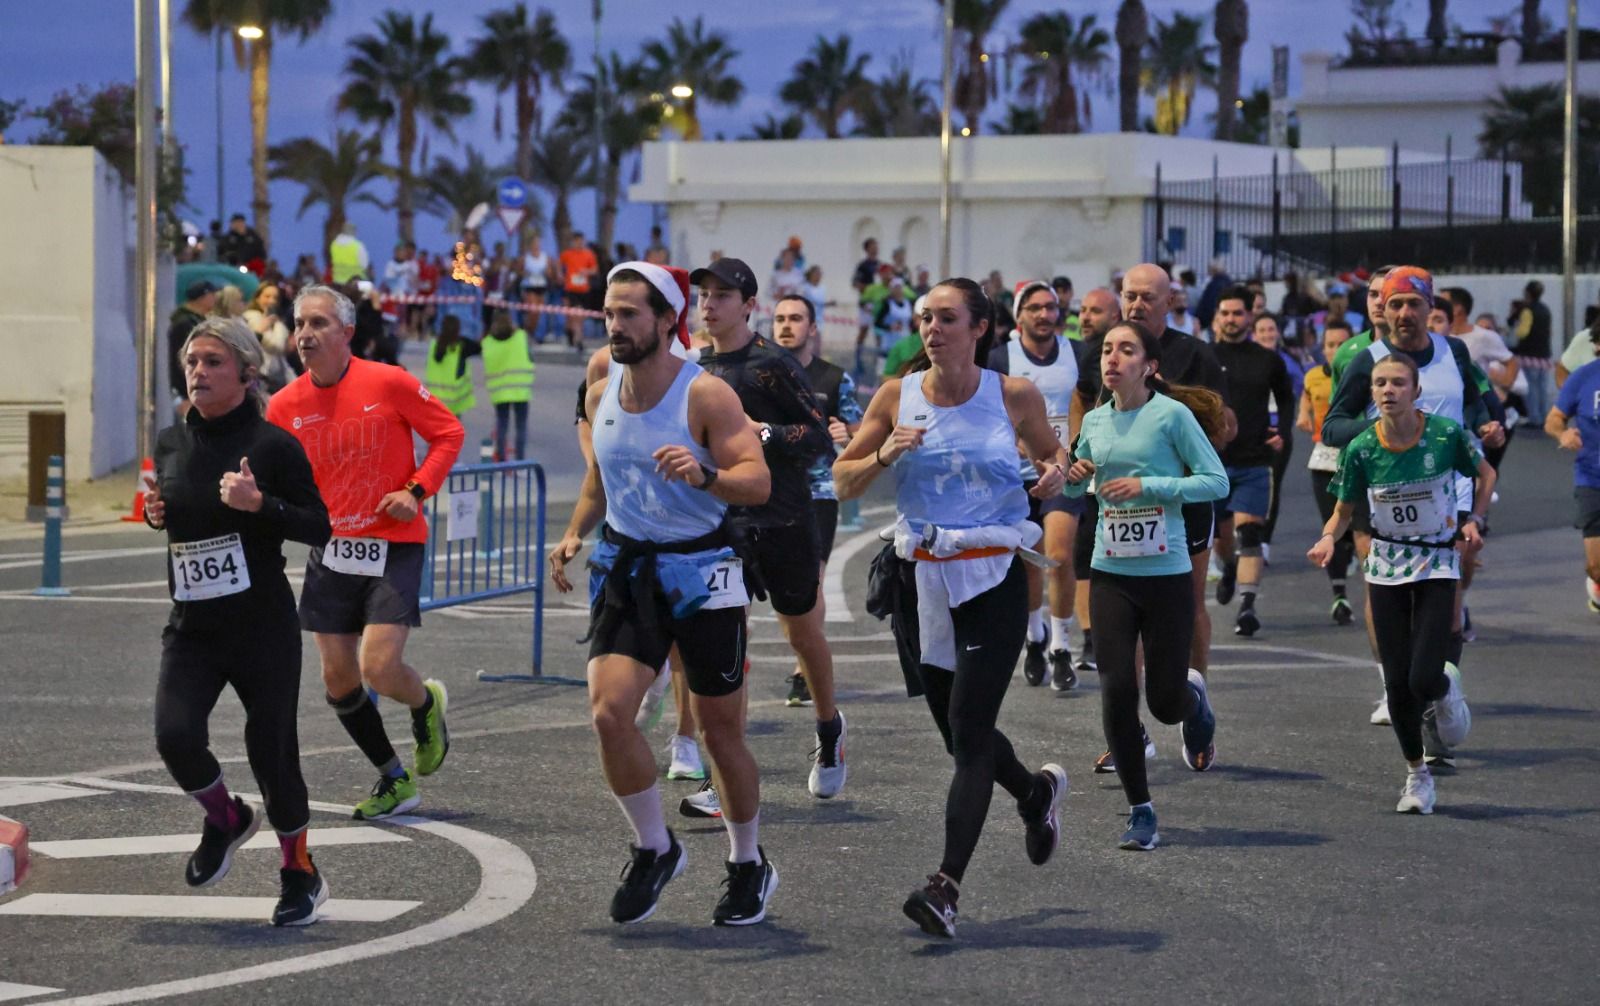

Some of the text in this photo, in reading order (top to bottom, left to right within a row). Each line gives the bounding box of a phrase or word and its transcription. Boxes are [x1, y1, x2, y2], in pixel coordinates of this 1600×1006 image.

[1392, 505, 1418, 524] 80
[1108, 520, 1158, 542] 1297
[331, 539, 380, 562] 1398
[179, 552, 238, 583] 1364
